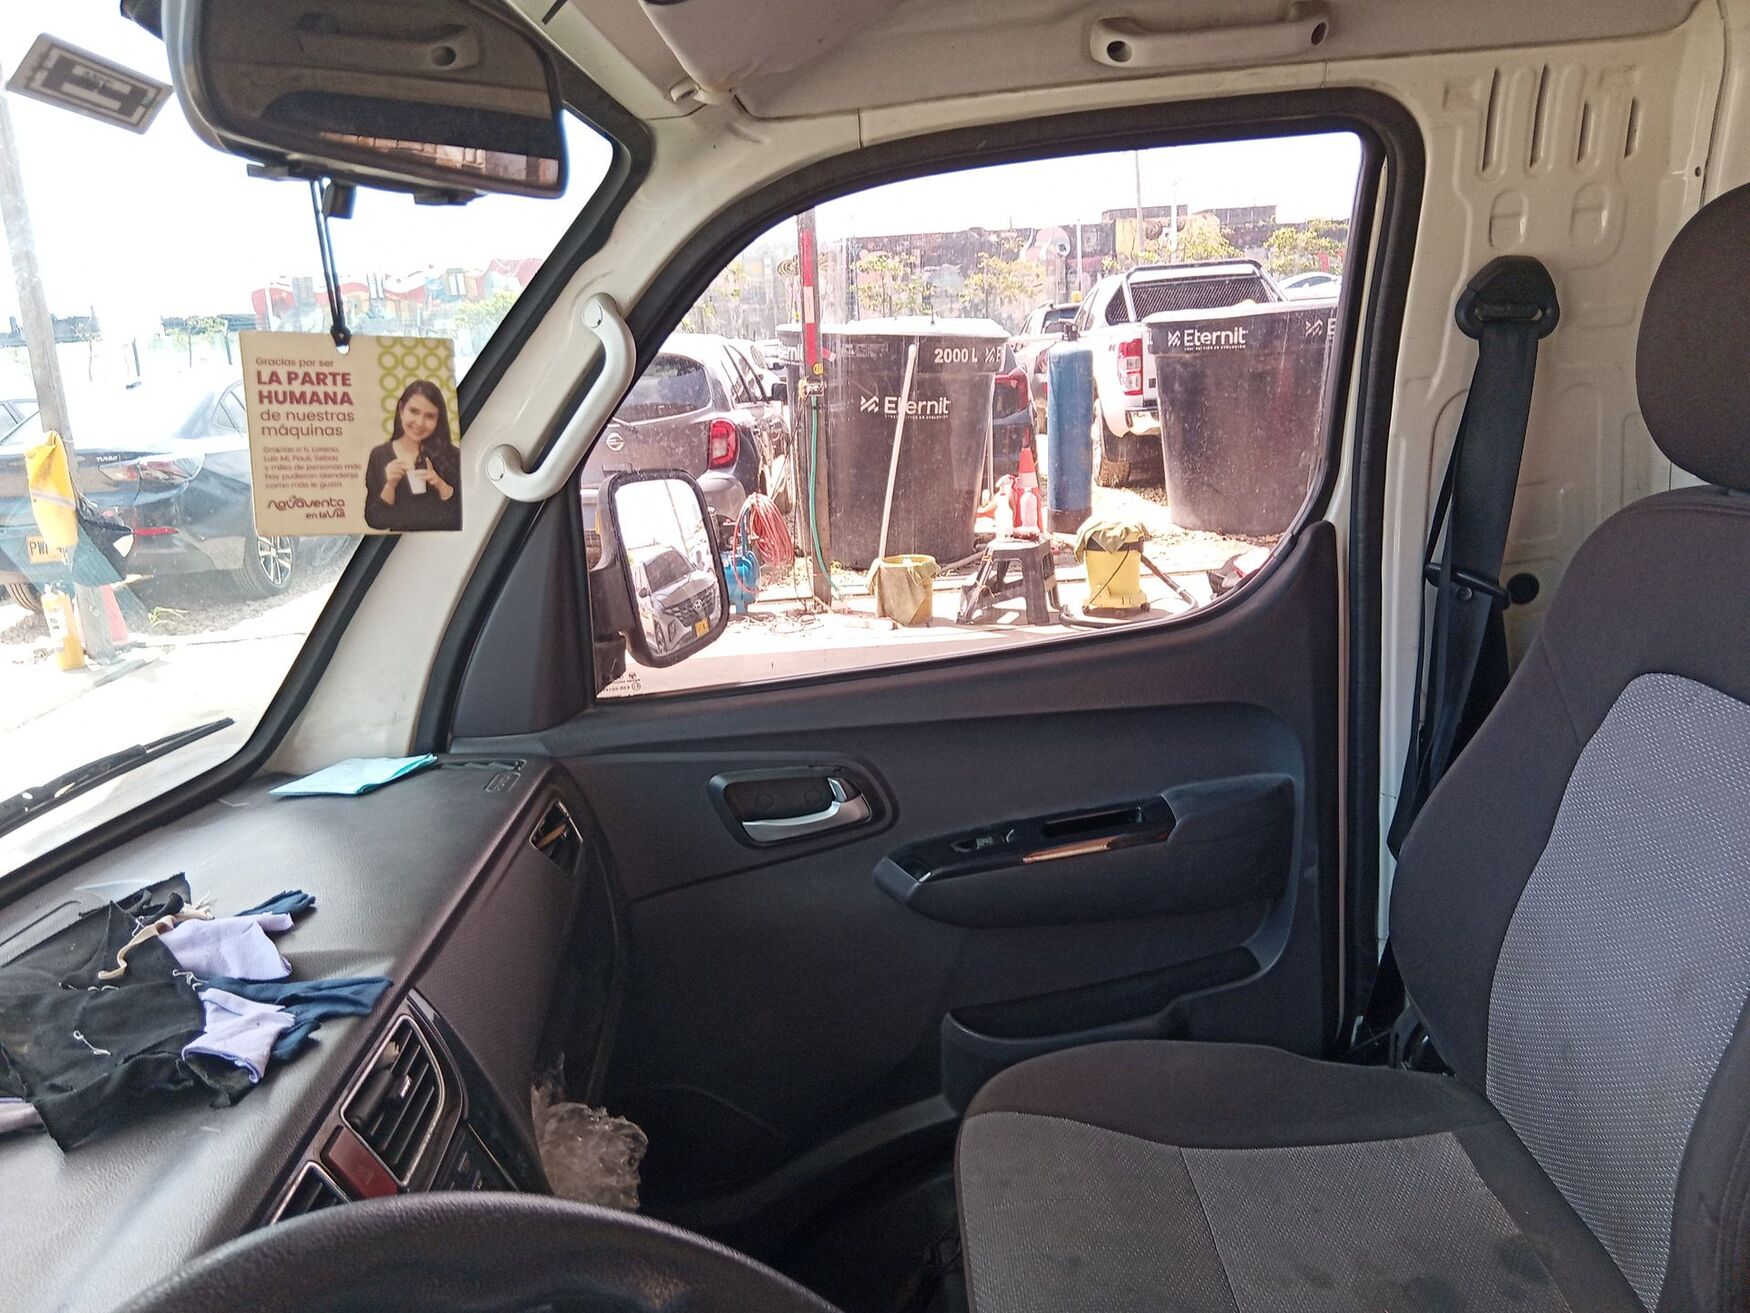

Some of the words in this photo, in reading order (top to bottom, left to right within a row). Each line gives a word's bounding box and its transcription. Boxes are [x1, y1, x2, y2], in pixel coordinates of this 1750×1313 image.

[1184, 327, 1247, 346] Eternit
[256, 357, 297, 367] Gracias
[299, 359, 315, 368] por
[319, 360, 334, 368] ser
[934, 348, 969, 364] 2000
[971, 347, 978, 363] L
[257, 370, 283, 385] LA
[287, 371, 352, 387] PARTE
[258, 390, 354, 406] HUMANA
[260, 408, 281, 422] de
[286, 410, 355, 422] nuestras
[262, 423, 344, 439] máquinas
